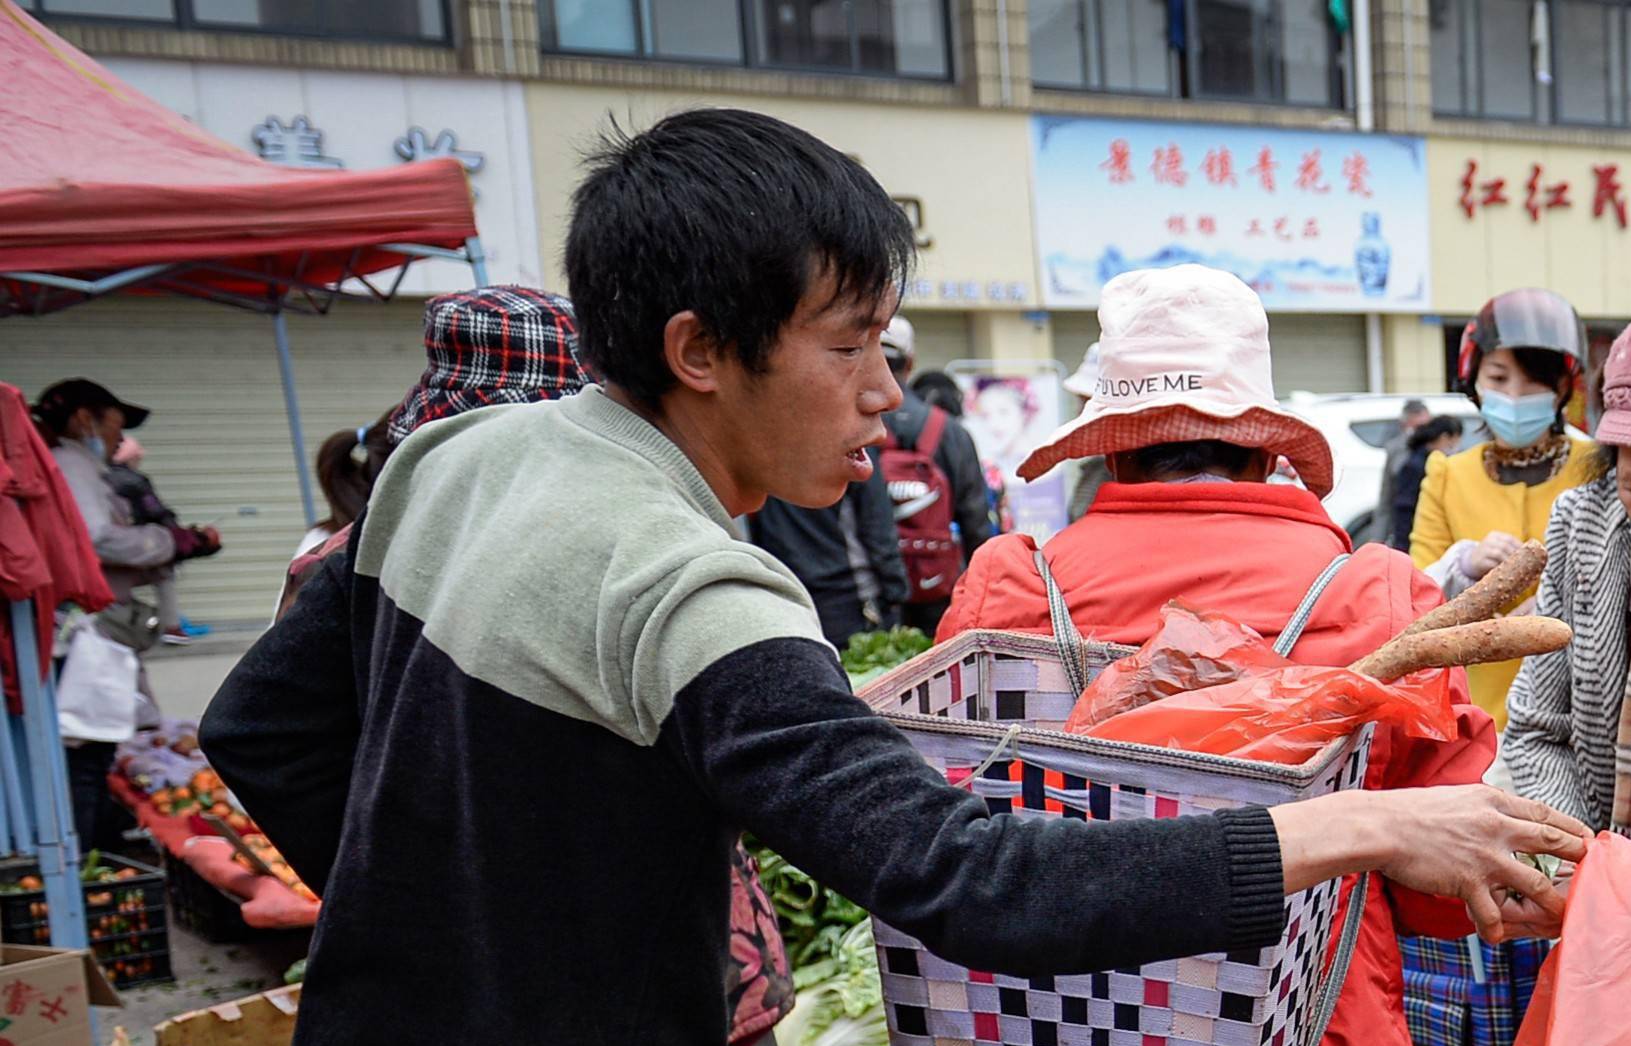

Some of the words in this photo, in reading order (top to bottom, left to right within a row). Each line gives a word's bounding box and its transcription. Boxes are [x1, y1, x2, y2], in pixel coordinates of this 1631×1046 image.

[1100, 138, 1374, 198] 景德镇青花瓷
[1110, 377, 1158, 397] LOVE
[1163, 373, 1203, 392] ME
